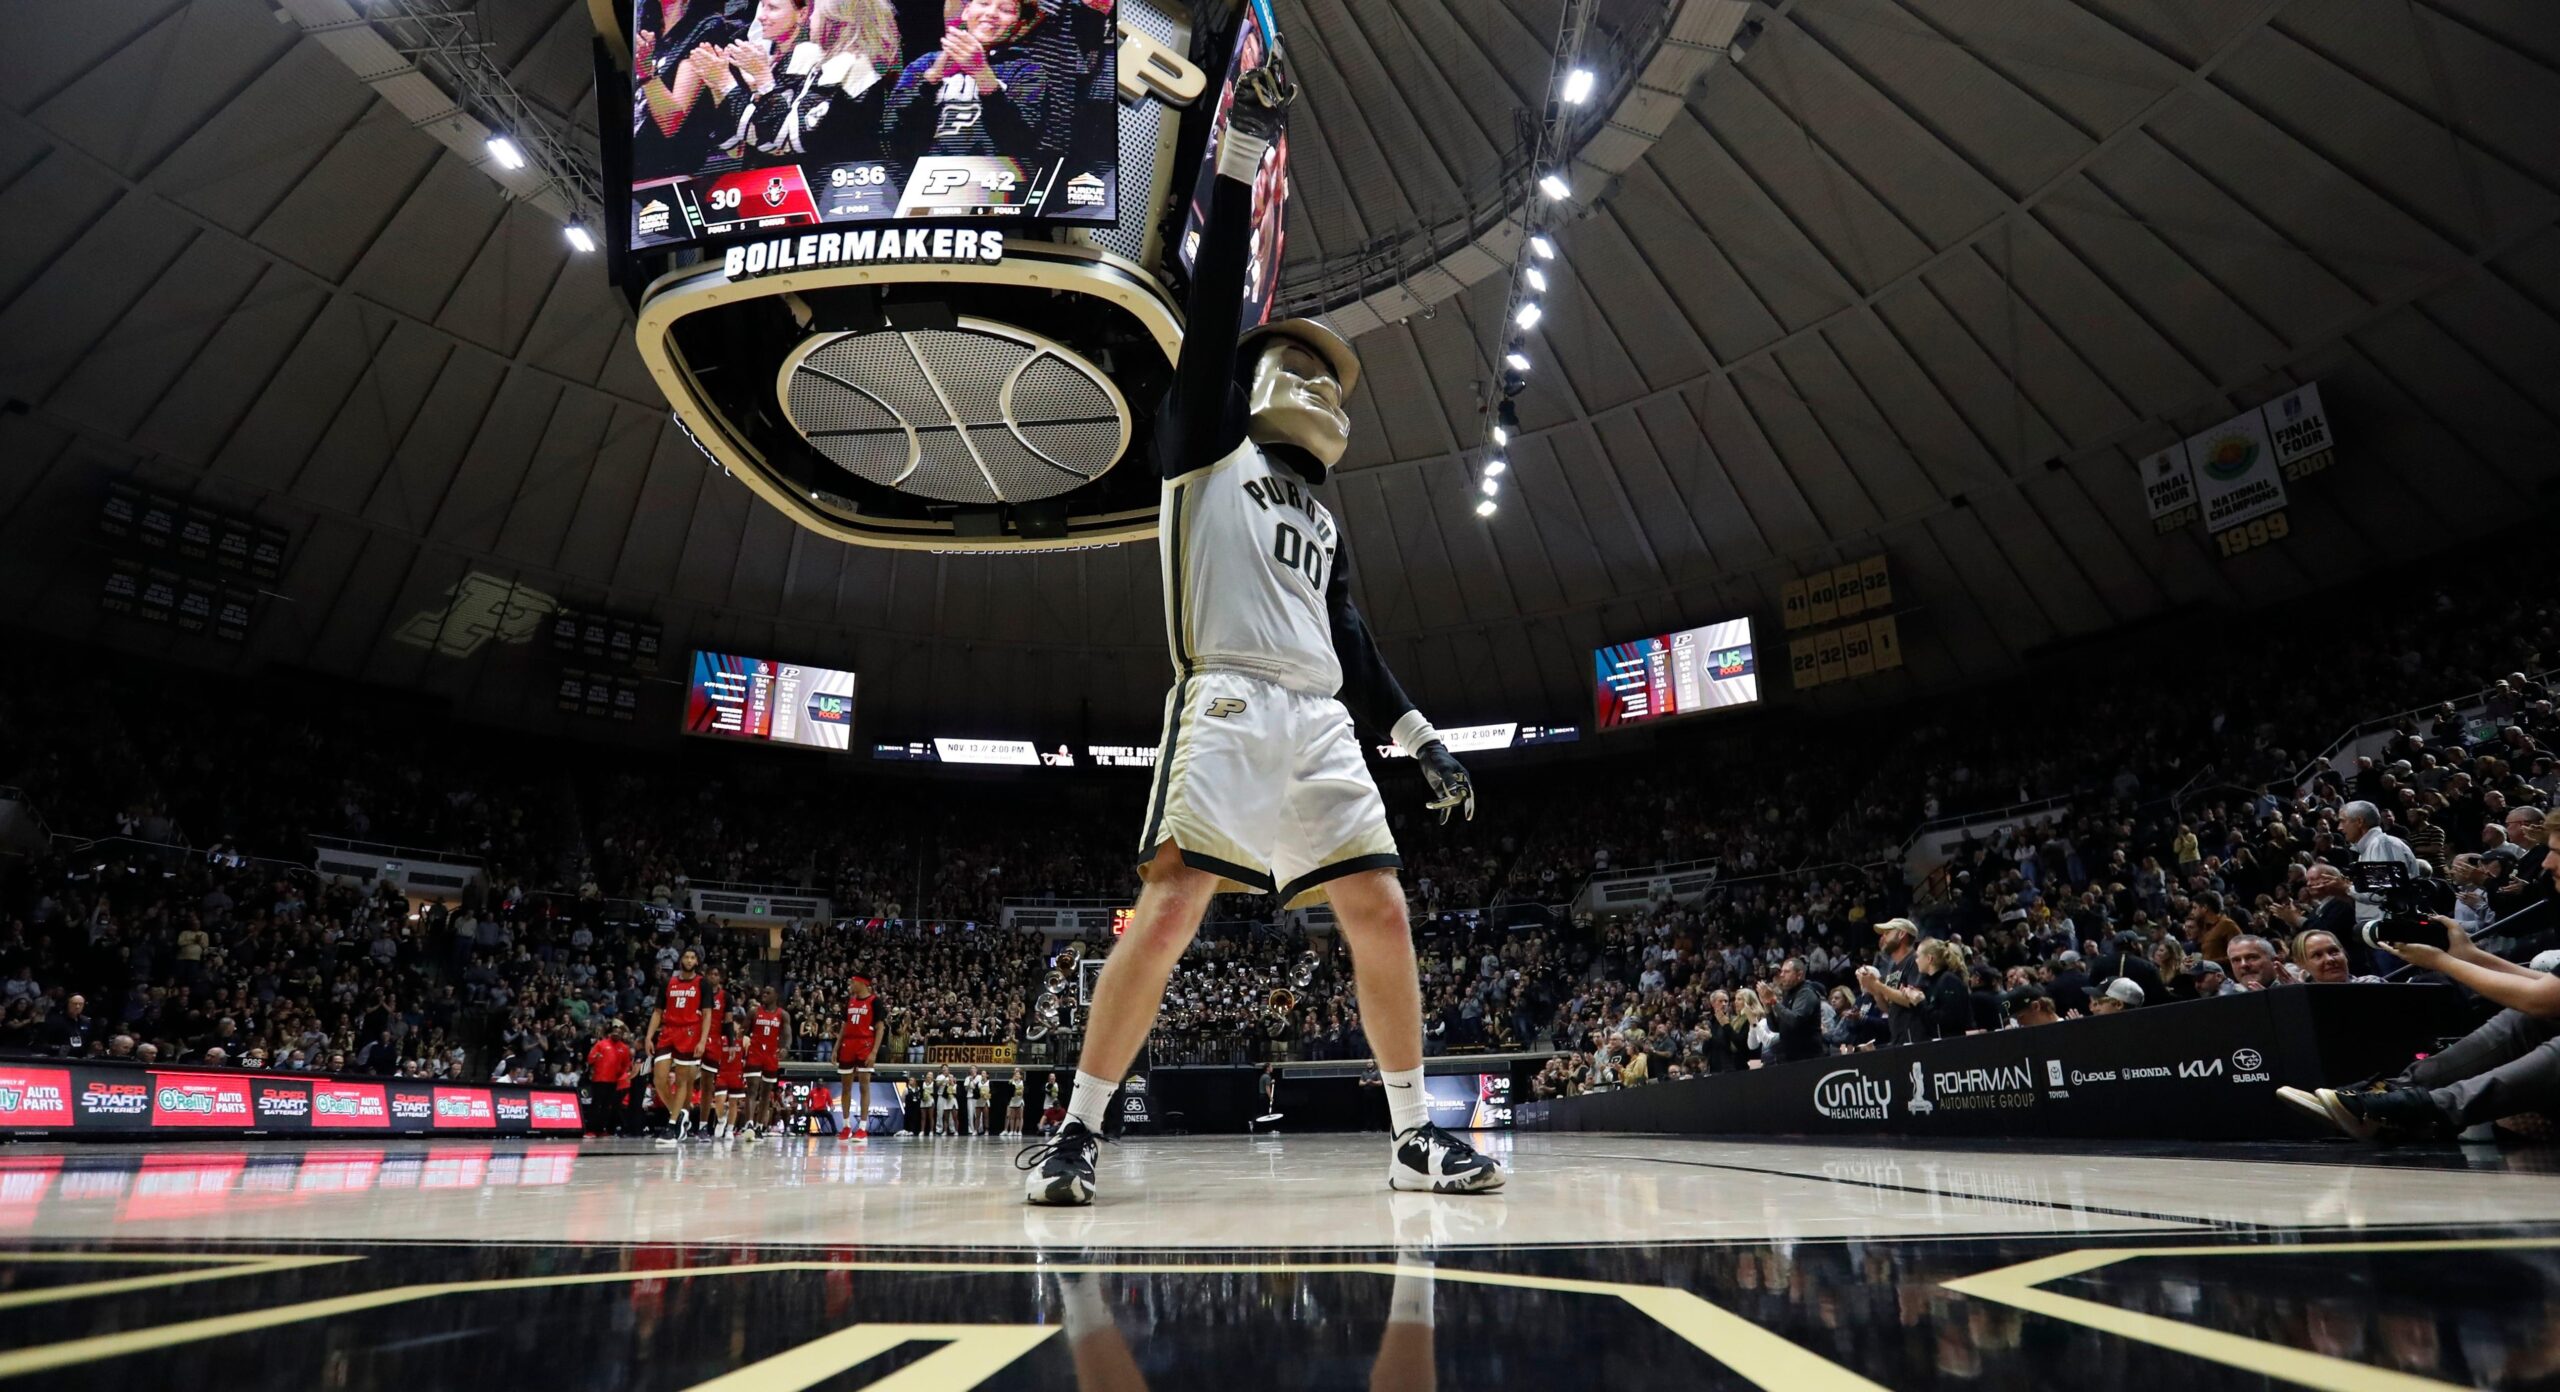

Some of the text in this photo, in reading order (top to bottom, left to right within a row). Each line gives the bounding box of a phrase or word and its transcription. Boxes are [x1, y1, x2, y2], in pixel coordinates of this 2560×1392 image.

[831, 166, 885, 188] 9:36
[922, 169, 1016, 196] P 42
[711, 188, 741, 210] 30
[993, 207, 1021, 215] FOULS
[707, 224, 732, 235] FOULS
[740, 223, 746, 231] 5
[724, 228, 1004, 278] BOILERMAKERS
[2275, 416, 2324, 445] FINAL
[2282, 429, 2325, 456] FOUR
[2285, 449, 2336, 483] 2001
[2148, 473, 2190, 498] FINAL
[2154, 486, 2190, 510] FOUR
[2211, 479, 2271, 509] NATIONAL
[2209, 487, 2280, 522] CHAMPIONS
[2216, 512, 2290, 558] 1999
[1274, 521, 1323, 591] 00
[1864, 572, 1886, 590] 32
[1812, 587, 1833, 604] 40
[1838, 580, 1860, 599] 22
[1787, 595, 1804, 611] 41
[1820, 646, 1842, 664] 32
[1846, 640, 1869, 658] 50
[1794, 653, 1815, 671] 22
[1719, 665, 1743, 675] FOODS
[1204, 697, 1247, 718] P
[819, 711, 841, 720] FOODS
[1450, 730, 1459, 740] 13
[1472, 729, 1490, 739] 2:00
[1492, 728, 1506, 737] PM
[969, 744, 978, 752] 13
[1011, 745, 1025, 754] PM
[1088, 746, 1134, 756] WOMEN'S
[1096, 755, 1155, 766] VS. MURRAY
[675, 997, 686, 1009] 12
[851, 1014, 861, 1025] 41
[928, 1047, 976, 1063] DEFENSE
[242, 1058, 262, 1067] POSS
[1934, 1057, 2033, 1100] ROHRMAN
[2083, 1071, 2117, 1082] LEXUS
[2131, 1066, 2172, 1078] HONDA
[2233, 1072, 2270, 1083] SUBARU
[89, 1082, 146, 1095] SUPER
[1494, 1078, 1510, 1089] 30
[27, 1085, 59, 1098] AUTO
[263, 1088, 307, 1099] SUPER
[793, 1085, 810, 1096] 30
[2048, 1090, 2069, 1099] TOYOTA
[81, 1092, 149, 1106] START
[158, 1087, 214, 1114] O'Reilly
[218, 1092, 242, 1103] AUTO
[258, 1097, 308, 1109] START
[361, 1097, 380, 1106] AUTO
[395, 1094, 429, 1103] SUPER
[1939, 1093, 2036, 1110] AUTOMOTIVE GROUP
[23, 1098, 64, 1111] PARTS
[216, 1103, 246, 1113] PARTS
[360, 1106, 383, 1115] PARTS
[392, 1101, 431, 1112] START
[497, 1104, 529, 1114] START
[1496, 1108, 1512, 1120] 42
[1831, 1108, 1881, 1120] HEALTHCARE
